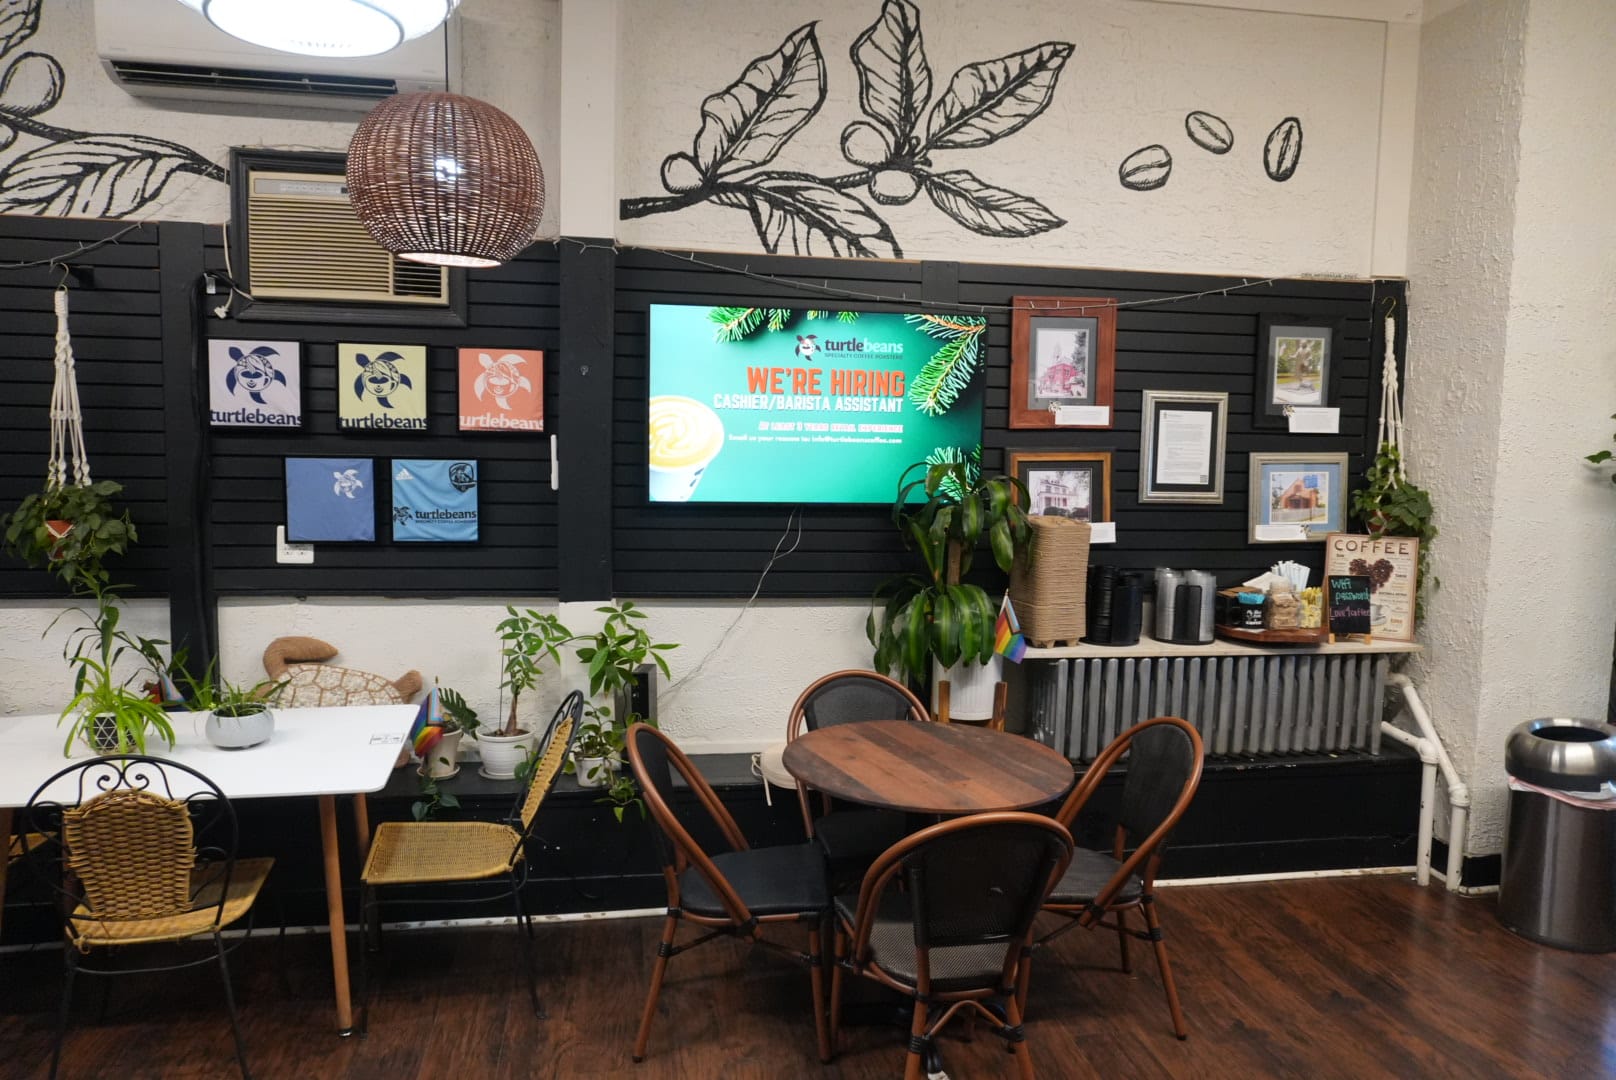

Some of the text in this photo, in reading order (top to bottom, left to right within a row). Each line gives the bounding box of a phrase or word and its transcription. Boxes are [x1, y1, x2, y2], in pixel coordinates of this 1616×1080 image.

[825, 337, 904, 353] turtlebeans
[831, 369, 905, 397] HIRING
[714, 394, 904, 412] CASHIER/BARISTA ASSISTANT
[210, 408, 302, 425] turtlebeans
[459, 413, 544, 430] urtlebeans
[415, 508, 477, 519] turtlebeans
[1334, 539, 1409, 555] COFFEE
